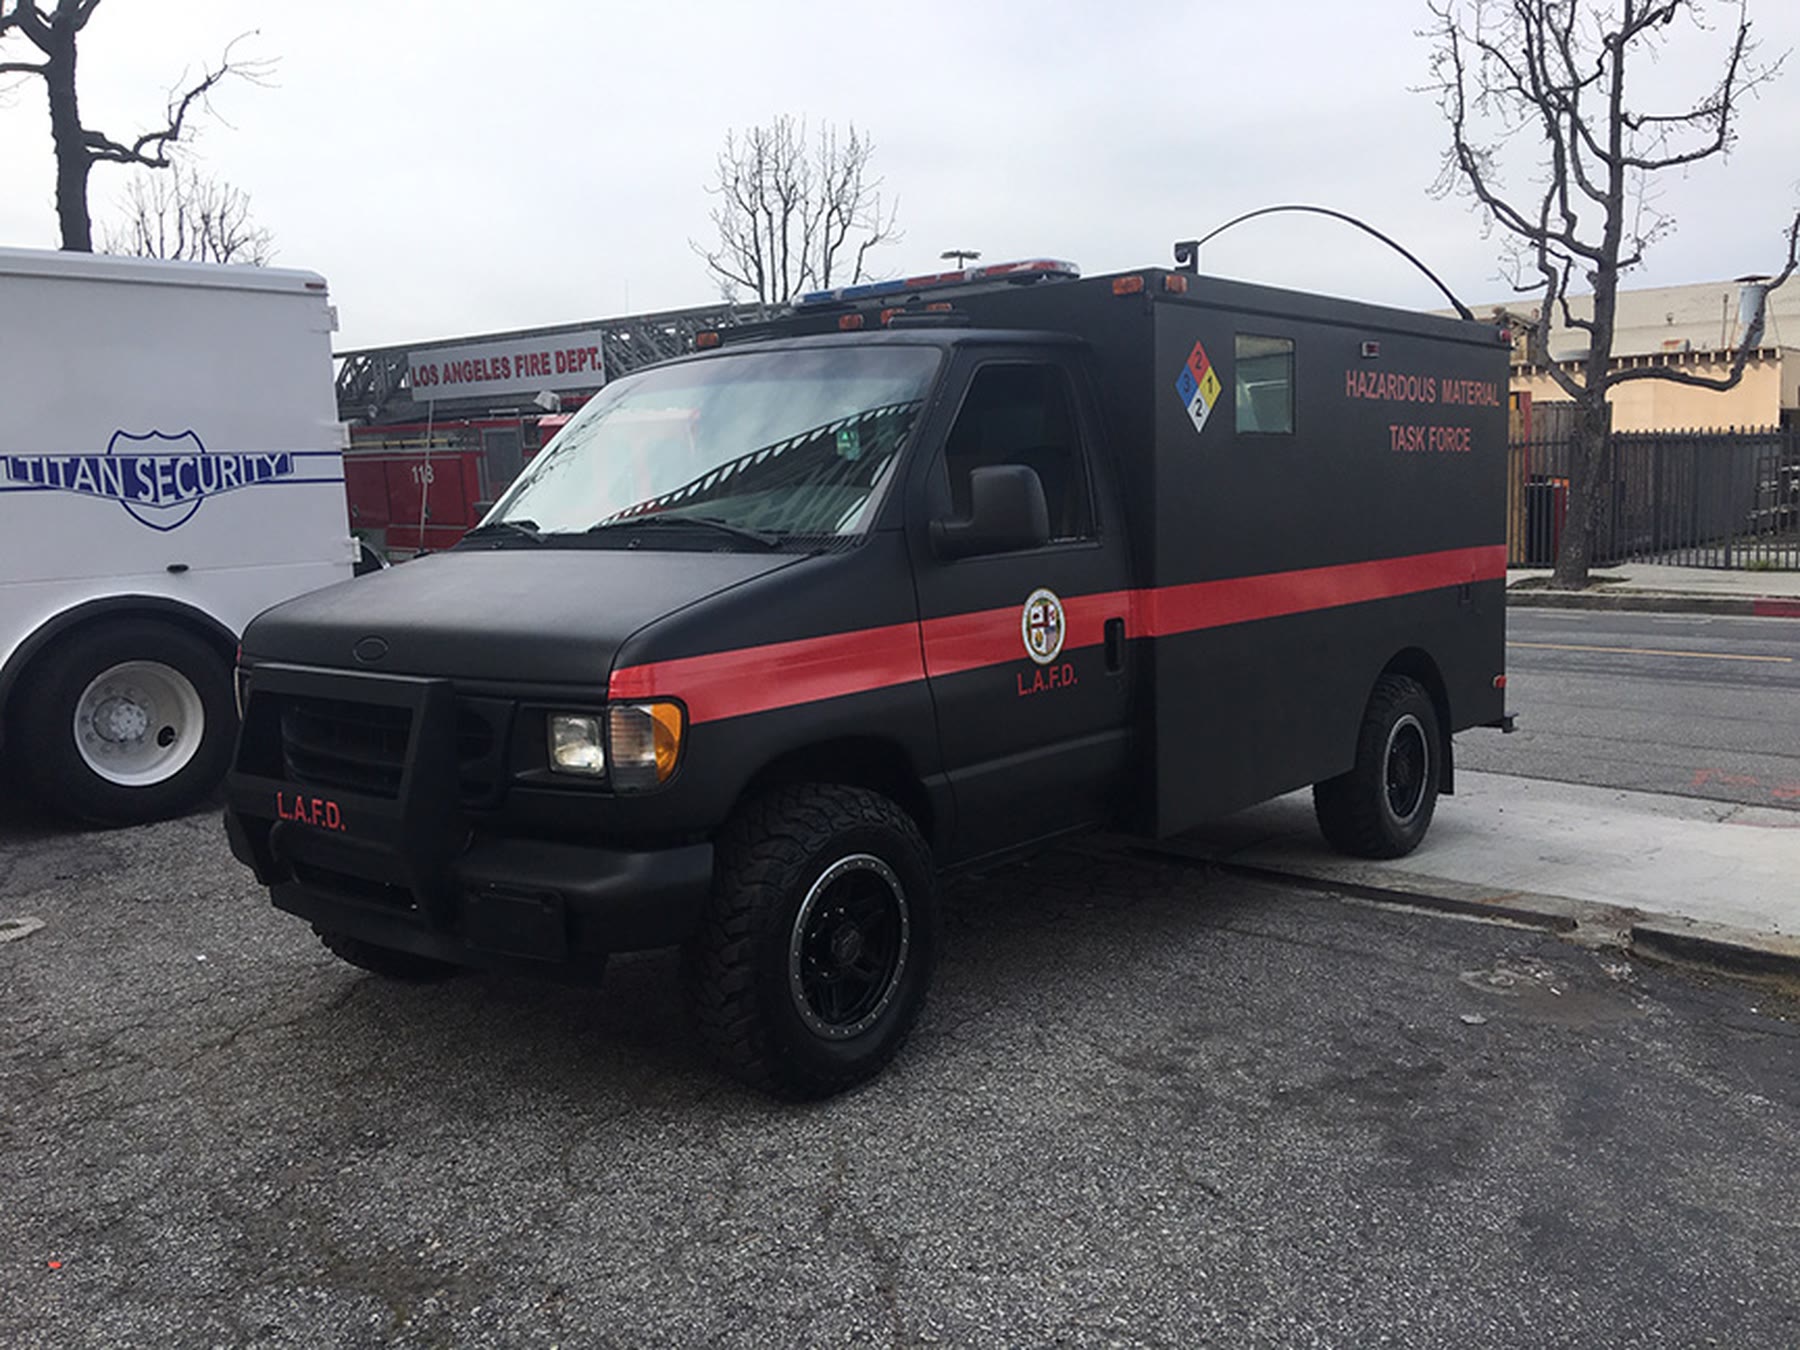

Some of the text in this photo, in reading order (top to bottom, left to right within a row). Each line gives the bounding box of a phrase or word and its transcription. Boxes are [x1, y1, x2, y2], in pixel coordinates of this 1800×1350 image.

[412, 346, 602, 388] LOS ANGELES FIRE DEPT.
[1195, 351, 1203, 369] 2
[1346, 370, 1500, 407] HAZARDOUS MATERIAL
[1195, 398, 1203, 417] 2
[1389, 424, 1471, 452] TASK FORCE
[18, 453, 282, 505] TITAN SECURITY
[1017, 663, 1078, 696] L.A.F.D.
[277, 791, 346, 831] L.A.F.D.
